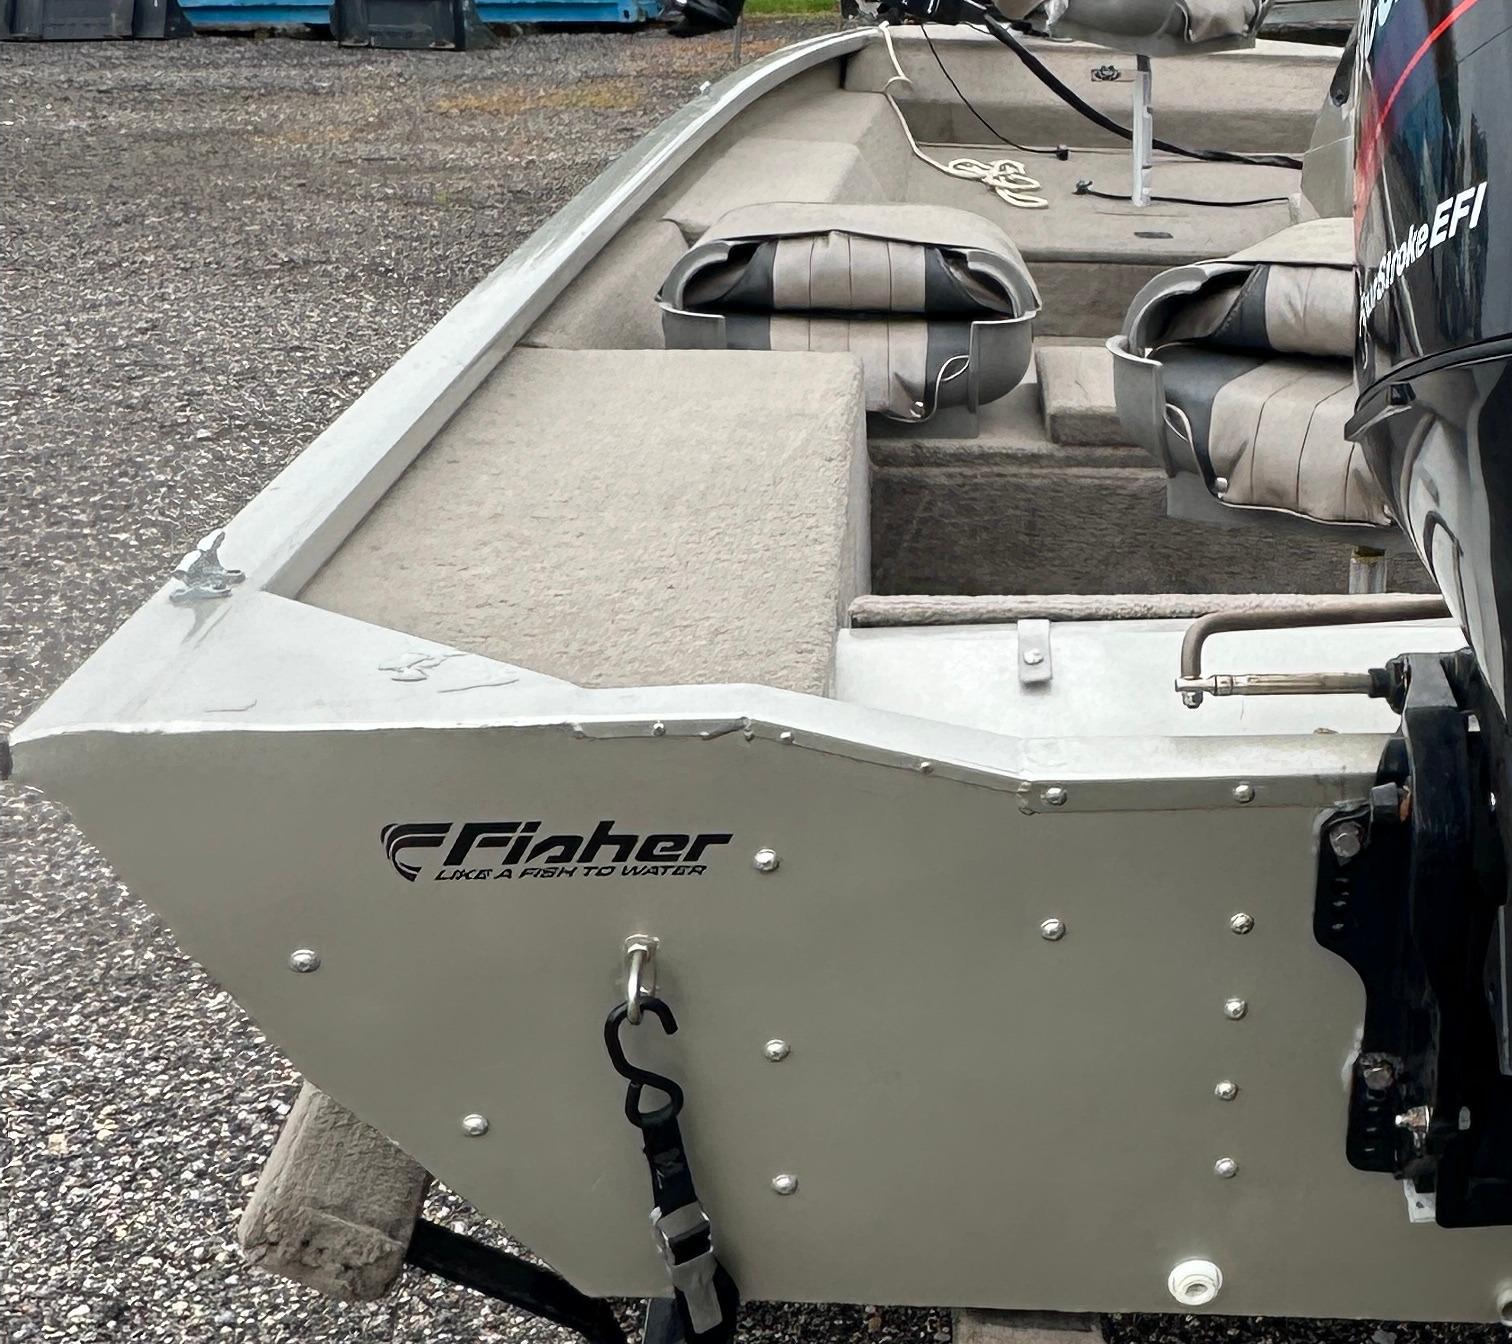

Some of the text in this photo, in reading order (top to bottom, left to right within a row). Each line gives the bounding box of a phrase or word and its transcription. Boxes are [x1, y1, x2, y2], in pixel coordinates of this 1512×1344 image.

[1429, 181, 1487, 249] EFI
[442, 820, 733, 867] Fisher
[434, 865, 707, 881] LIKE A FISH TO WATER
